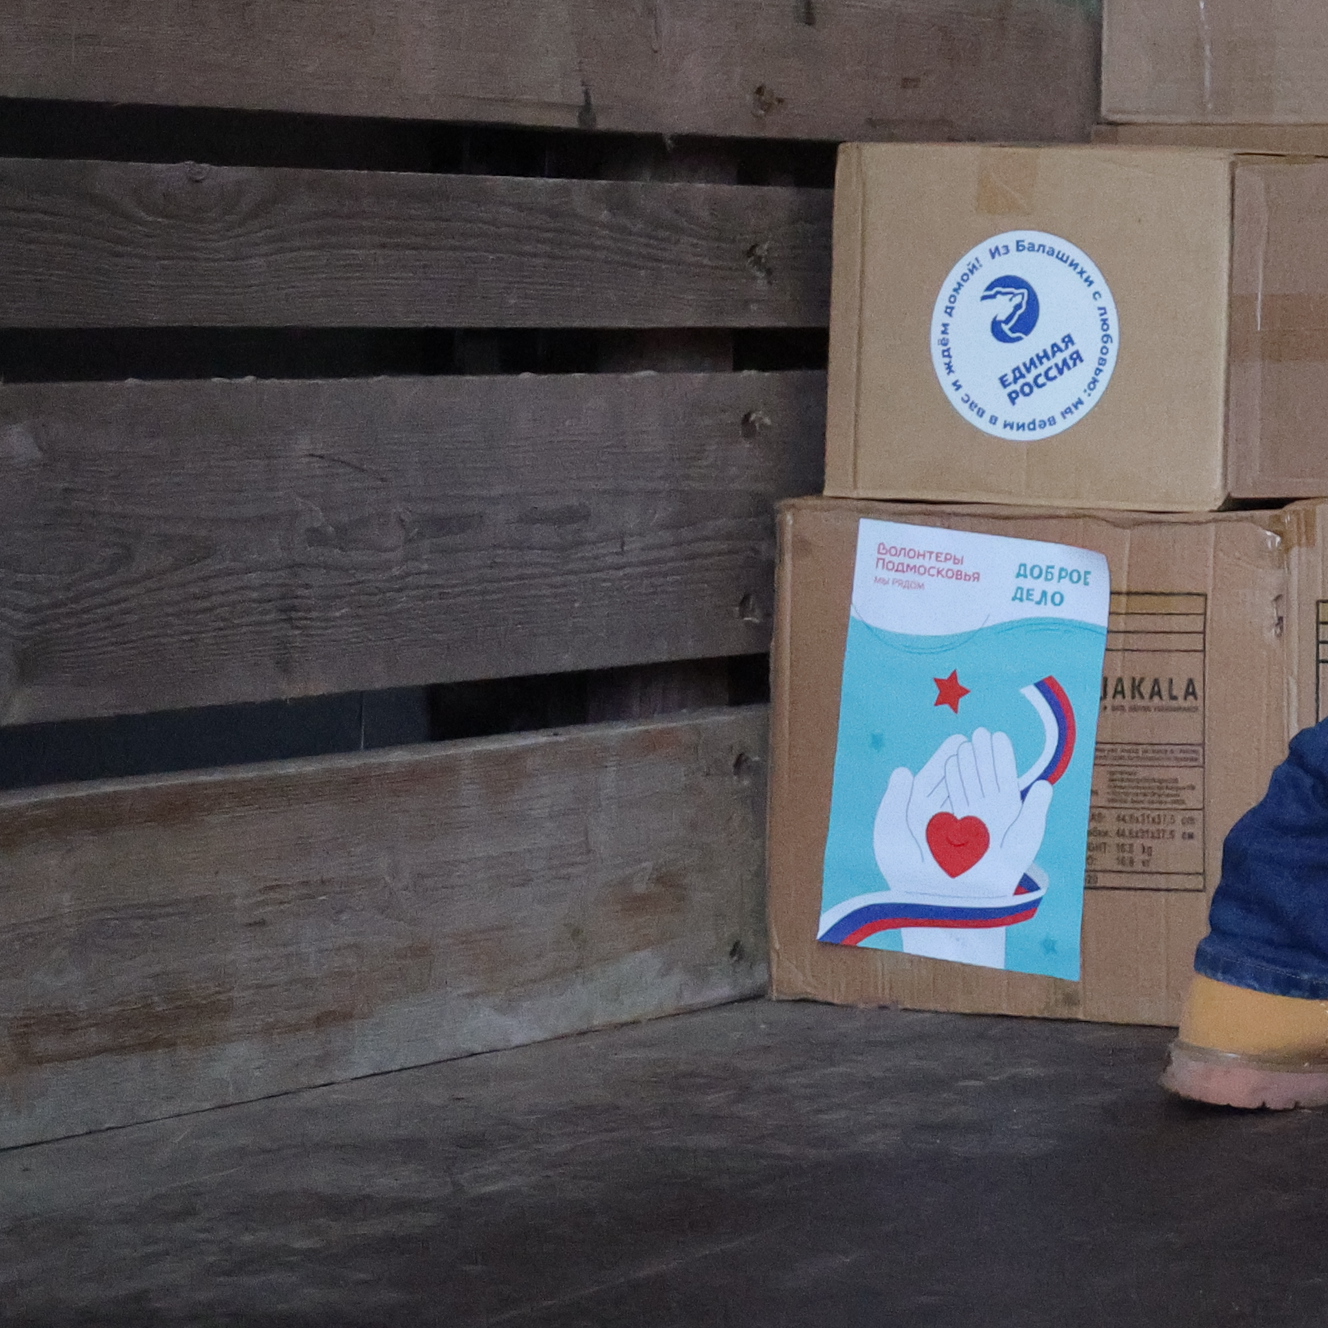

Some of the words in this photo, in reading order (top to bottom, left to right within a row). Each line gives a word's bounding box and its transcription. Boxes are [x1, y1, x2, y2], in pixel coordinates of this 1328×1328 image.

[989, 245, 1010, 259] Из
[1016, 240, 1095, 288] Балашихи
[944, 257, 983, 317] домой!
[1092, 291, 1101, 301] с
[938, 323, 955, 375] ждём
[1083, 306, 1113, 397] любовью:
[998, 333, 1075, 389] ЕДИНАЯ
[952, 379, 962, 392] и
[1007, 349, 1084, 406] РОССИЯ
[961, 394, 986, 418] вас
[1061, 397, 1084, 419] мы
[989, 415, 998, 425] в
[1003, 416, 1057, 431] верим
[1015, 563, 1092, 586] ДОБРОЕ
[1011, 586, 1065, 607] ДЕЛО
